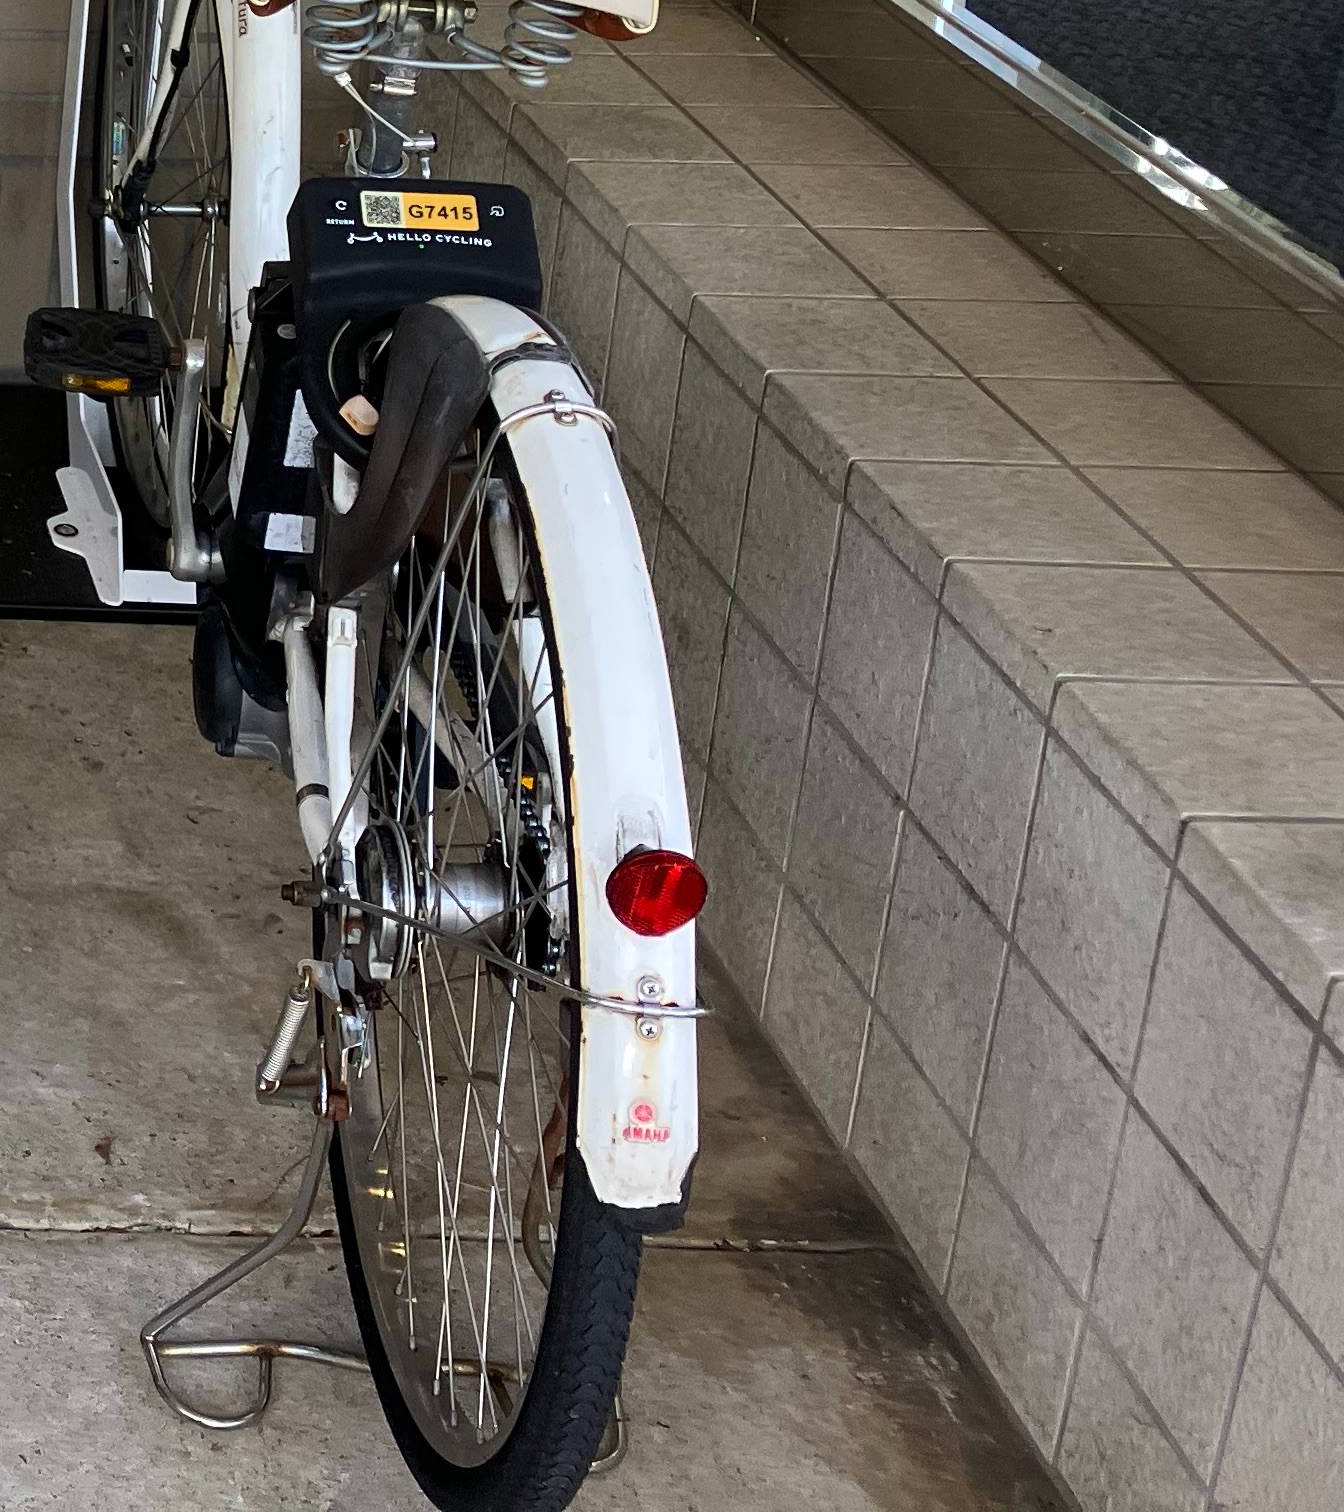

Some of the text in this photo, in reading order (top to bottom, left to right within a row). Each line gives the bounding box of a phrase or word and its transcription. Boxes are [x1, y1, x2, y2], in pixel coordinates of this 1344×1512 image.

[408, 204, 473, 220] G7415
[388, 233, 492, 247] HELLO CYCLING
